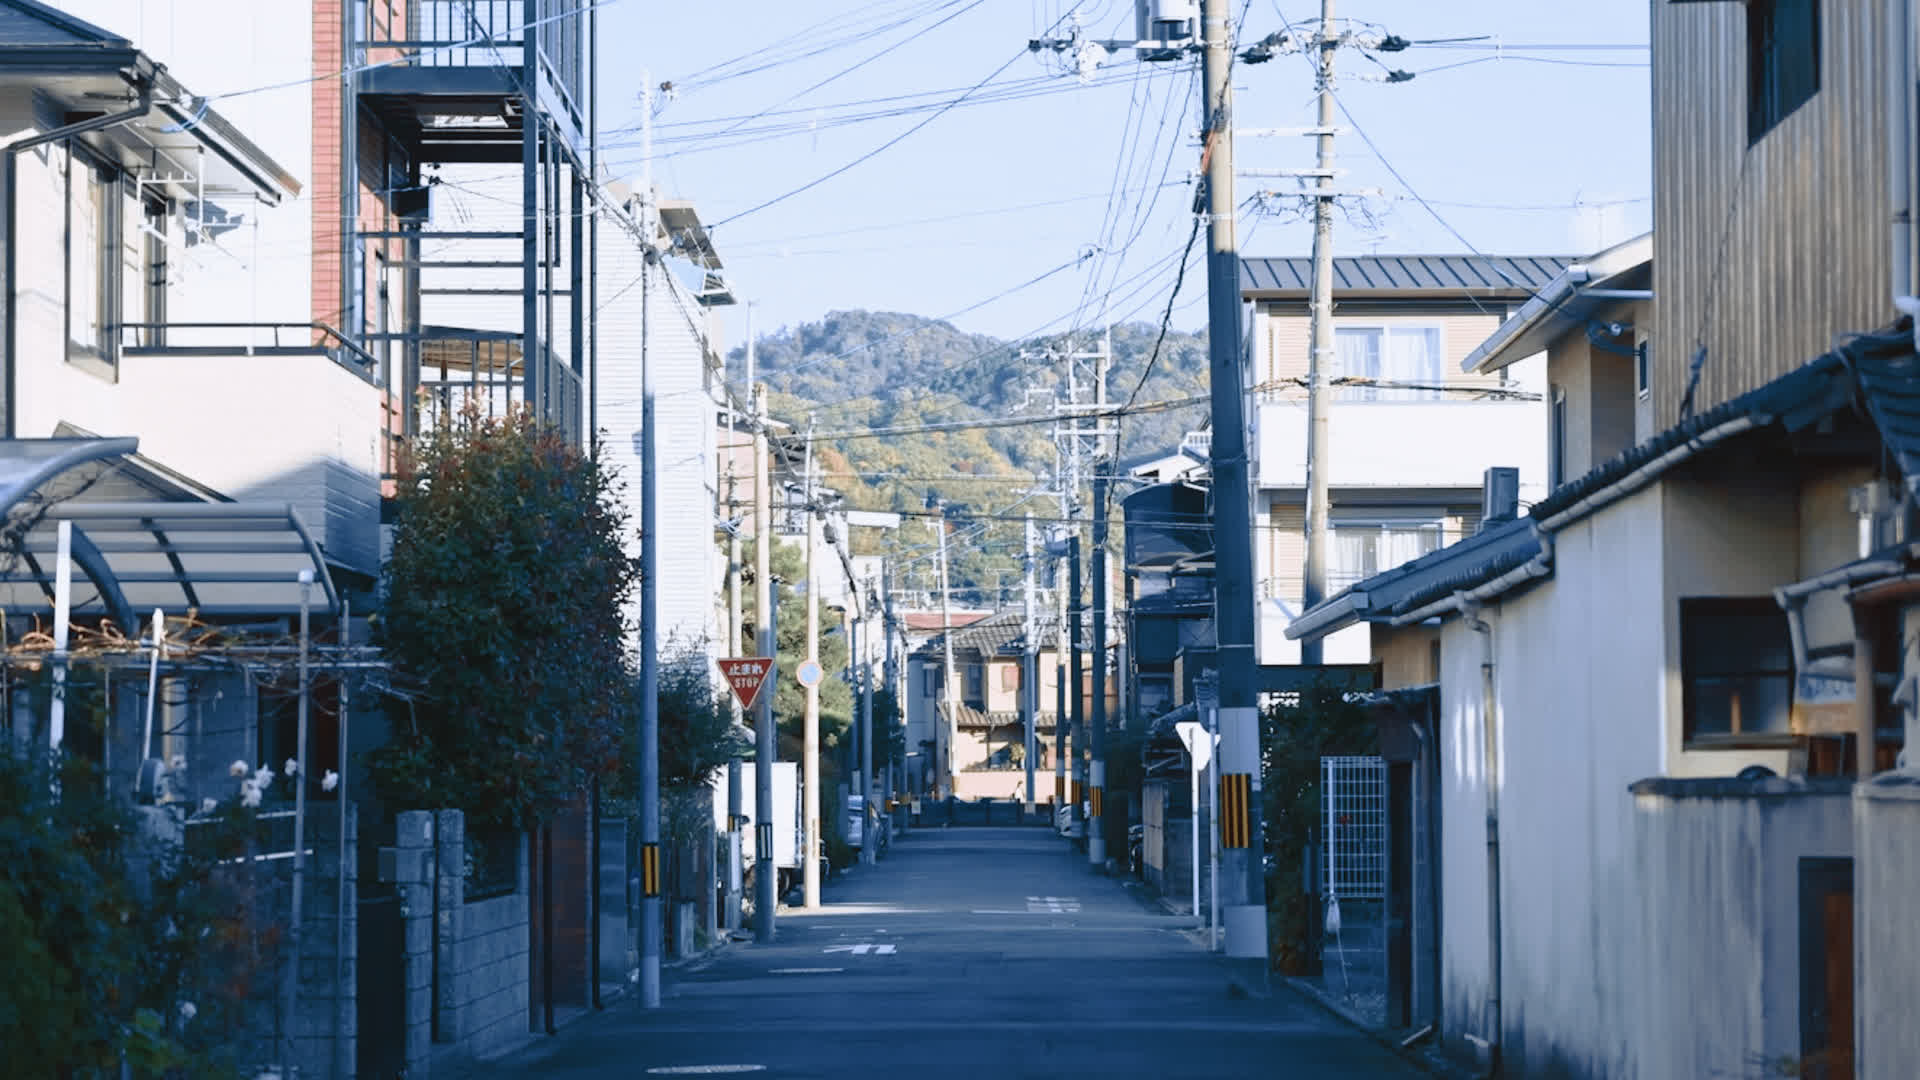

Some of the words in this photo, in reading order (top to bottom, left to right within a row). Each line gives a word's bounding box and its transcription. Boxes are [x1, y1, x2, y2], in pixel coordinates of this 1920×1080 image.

[728, 663, 763, 675] 止まれ
[735, 677, 759, 688] STOP
